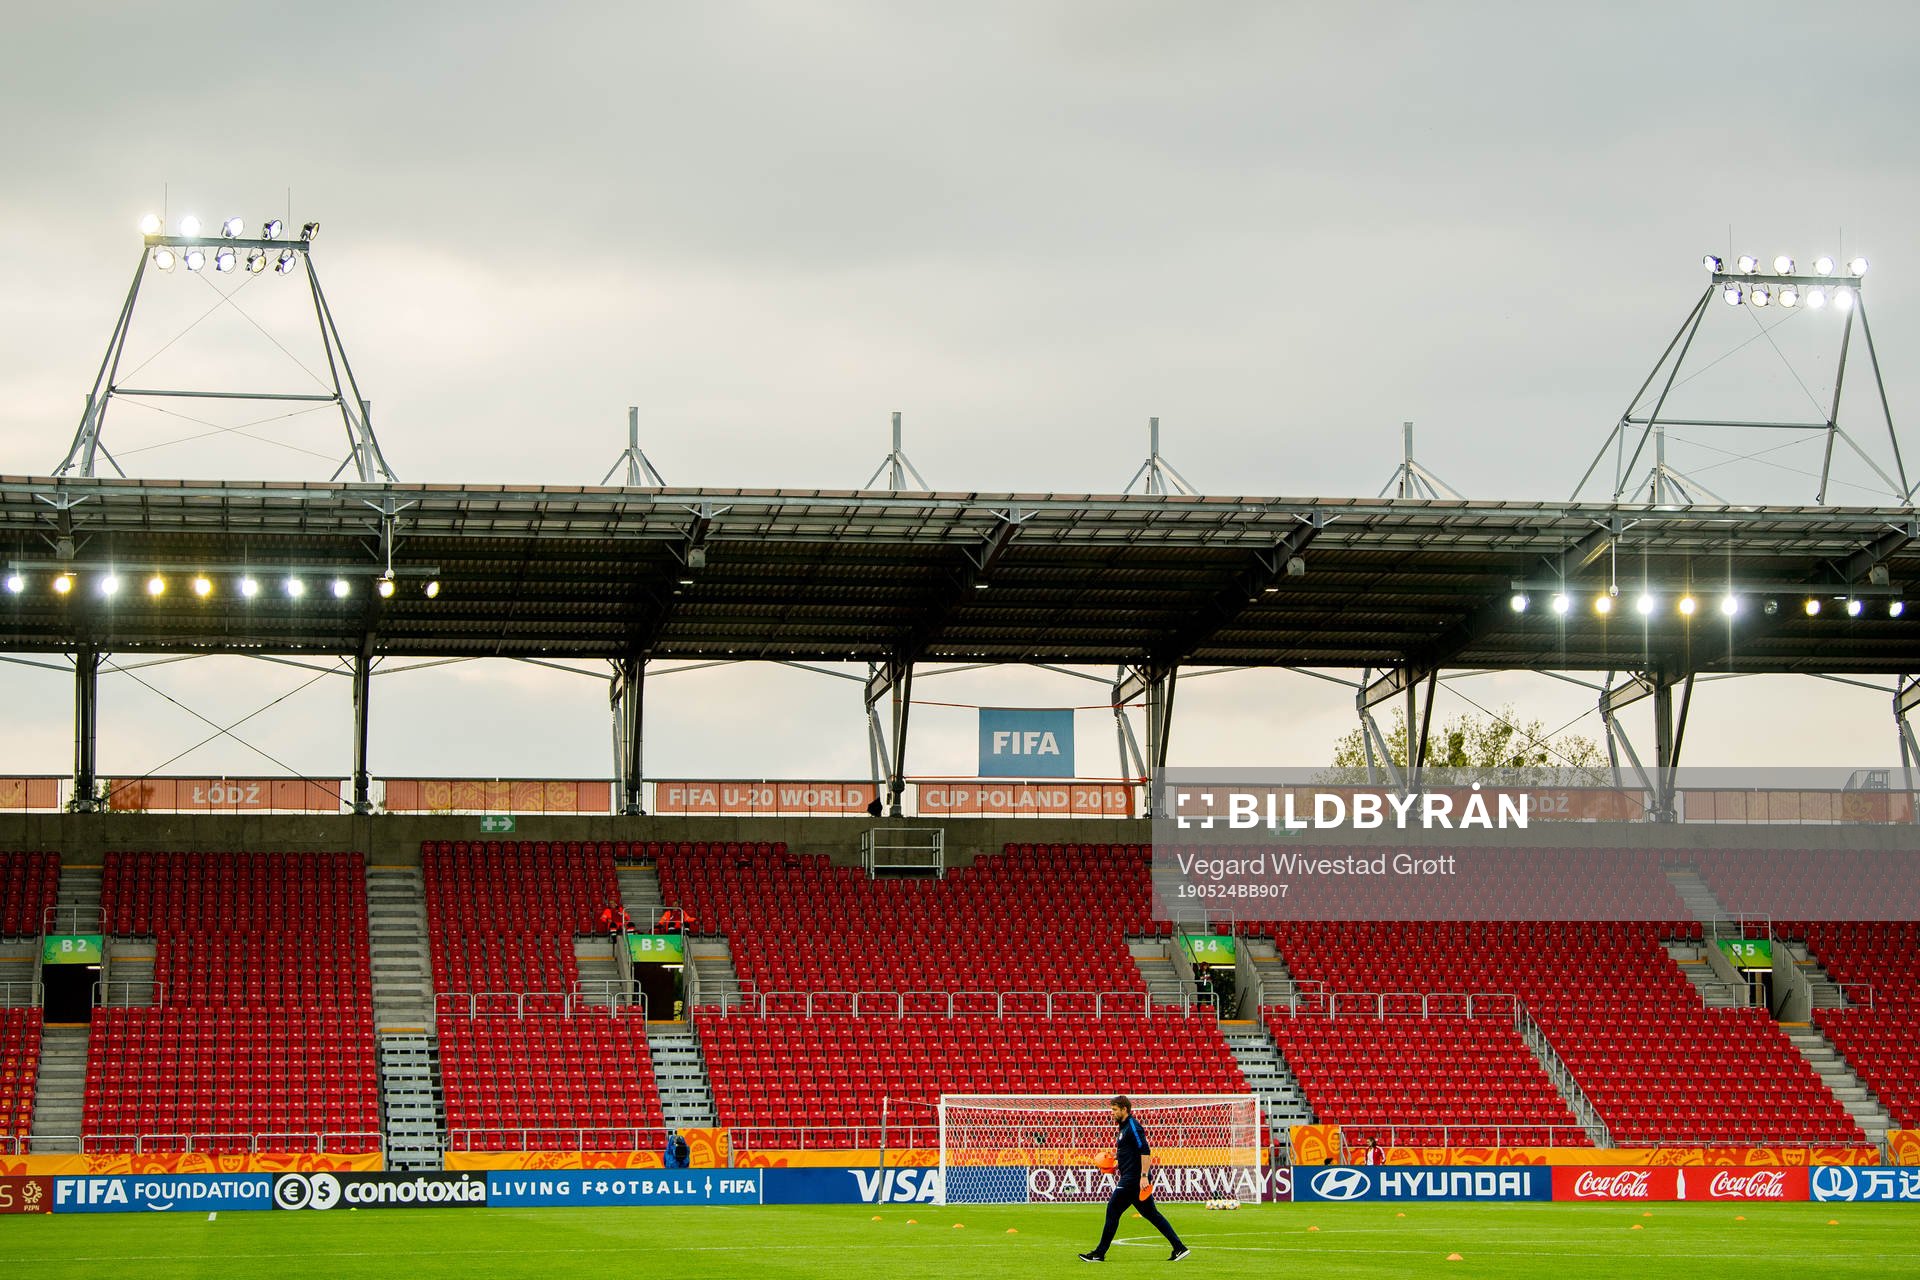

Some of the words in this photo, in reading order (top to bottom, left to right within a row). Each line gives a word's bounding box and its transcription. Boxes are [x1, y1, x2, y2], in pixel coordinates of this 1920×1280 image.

[993, 731, 1060, 755] FIFA
[192, 782, 260, 804] ŁÓDŹ
[669, 788, 717, 806] FIFA
[724, 788, 774, 806] U-20
[780, 789, 864, 807] WORLD
[925, 790, 969, 808] CUP
[976, 790, 1069, 808] POLAND
[1075, 791, 1127, 809] 2019
[1510, 792, 1569, 813] ÓDŹ
[62, 939, 73, 953] B
[77, 939, 87, 952] 2
[641, 938, 652, 951] B
[655, 938, 665, 951] 3
[1194, 939, 1204, 952] B
[1207, 940, 1217, 952] 4
[1732, 943, 1742, 956] B
[1746, 943, 1755, 956] 5
[56, 1179, 128, 1204] FIFA
[134, 1181, 270, 1199] FOUNDATION
[344, 1174, 486, 1203] conotoxia
[492, 1181, 570, 1196] LIVING
[719, 1180, 756, 1194] FIFA
[848, 1169, 940, 1202] VISA
[1029, 1168, 1119, 1200] QATA
[1151, 1168, 1291, 1194] AIRWAYS
[1380, 1172, 1530, 1196] HYUNDAI
[1574, 1170, 1651, 1197] Coca-Cola
[1709, 1170, 1786, 1197] Coca-Cola
